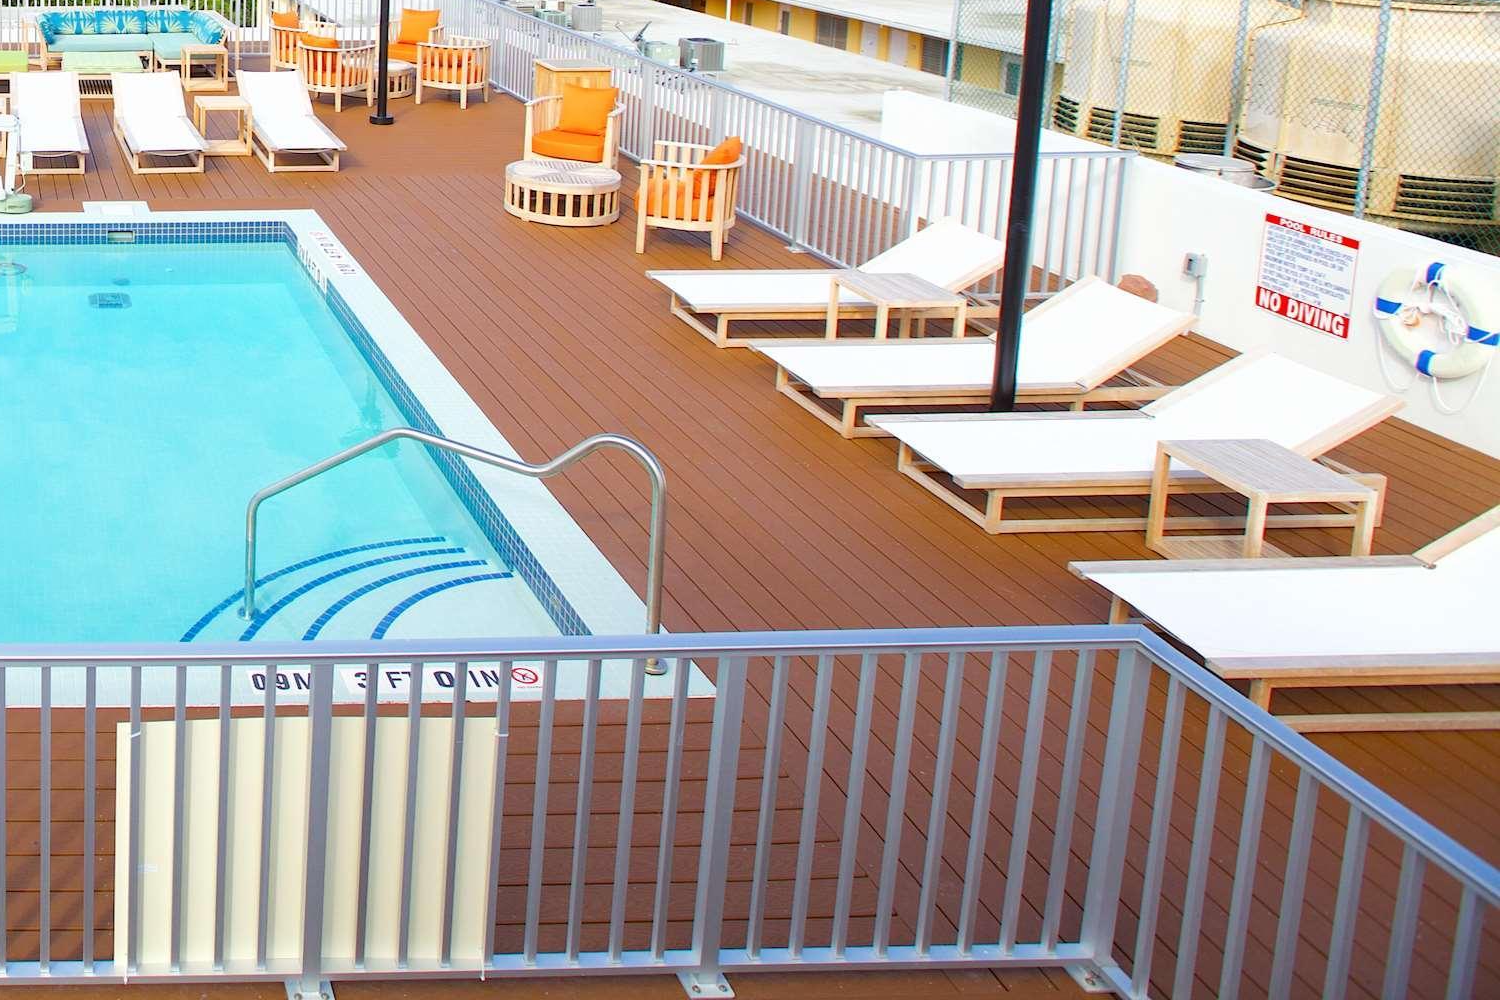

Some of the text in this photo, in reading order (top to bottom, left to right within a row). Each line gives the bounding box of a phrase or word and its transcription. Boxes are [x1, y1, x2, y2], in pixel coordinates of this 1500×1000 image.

[1279, 218, 1343, 244] POOL RULES
[1258, 287, 1345, 338] NO DIVING
[354, 671, 368, 689] 3
[468, 669, 500, 688] IN
